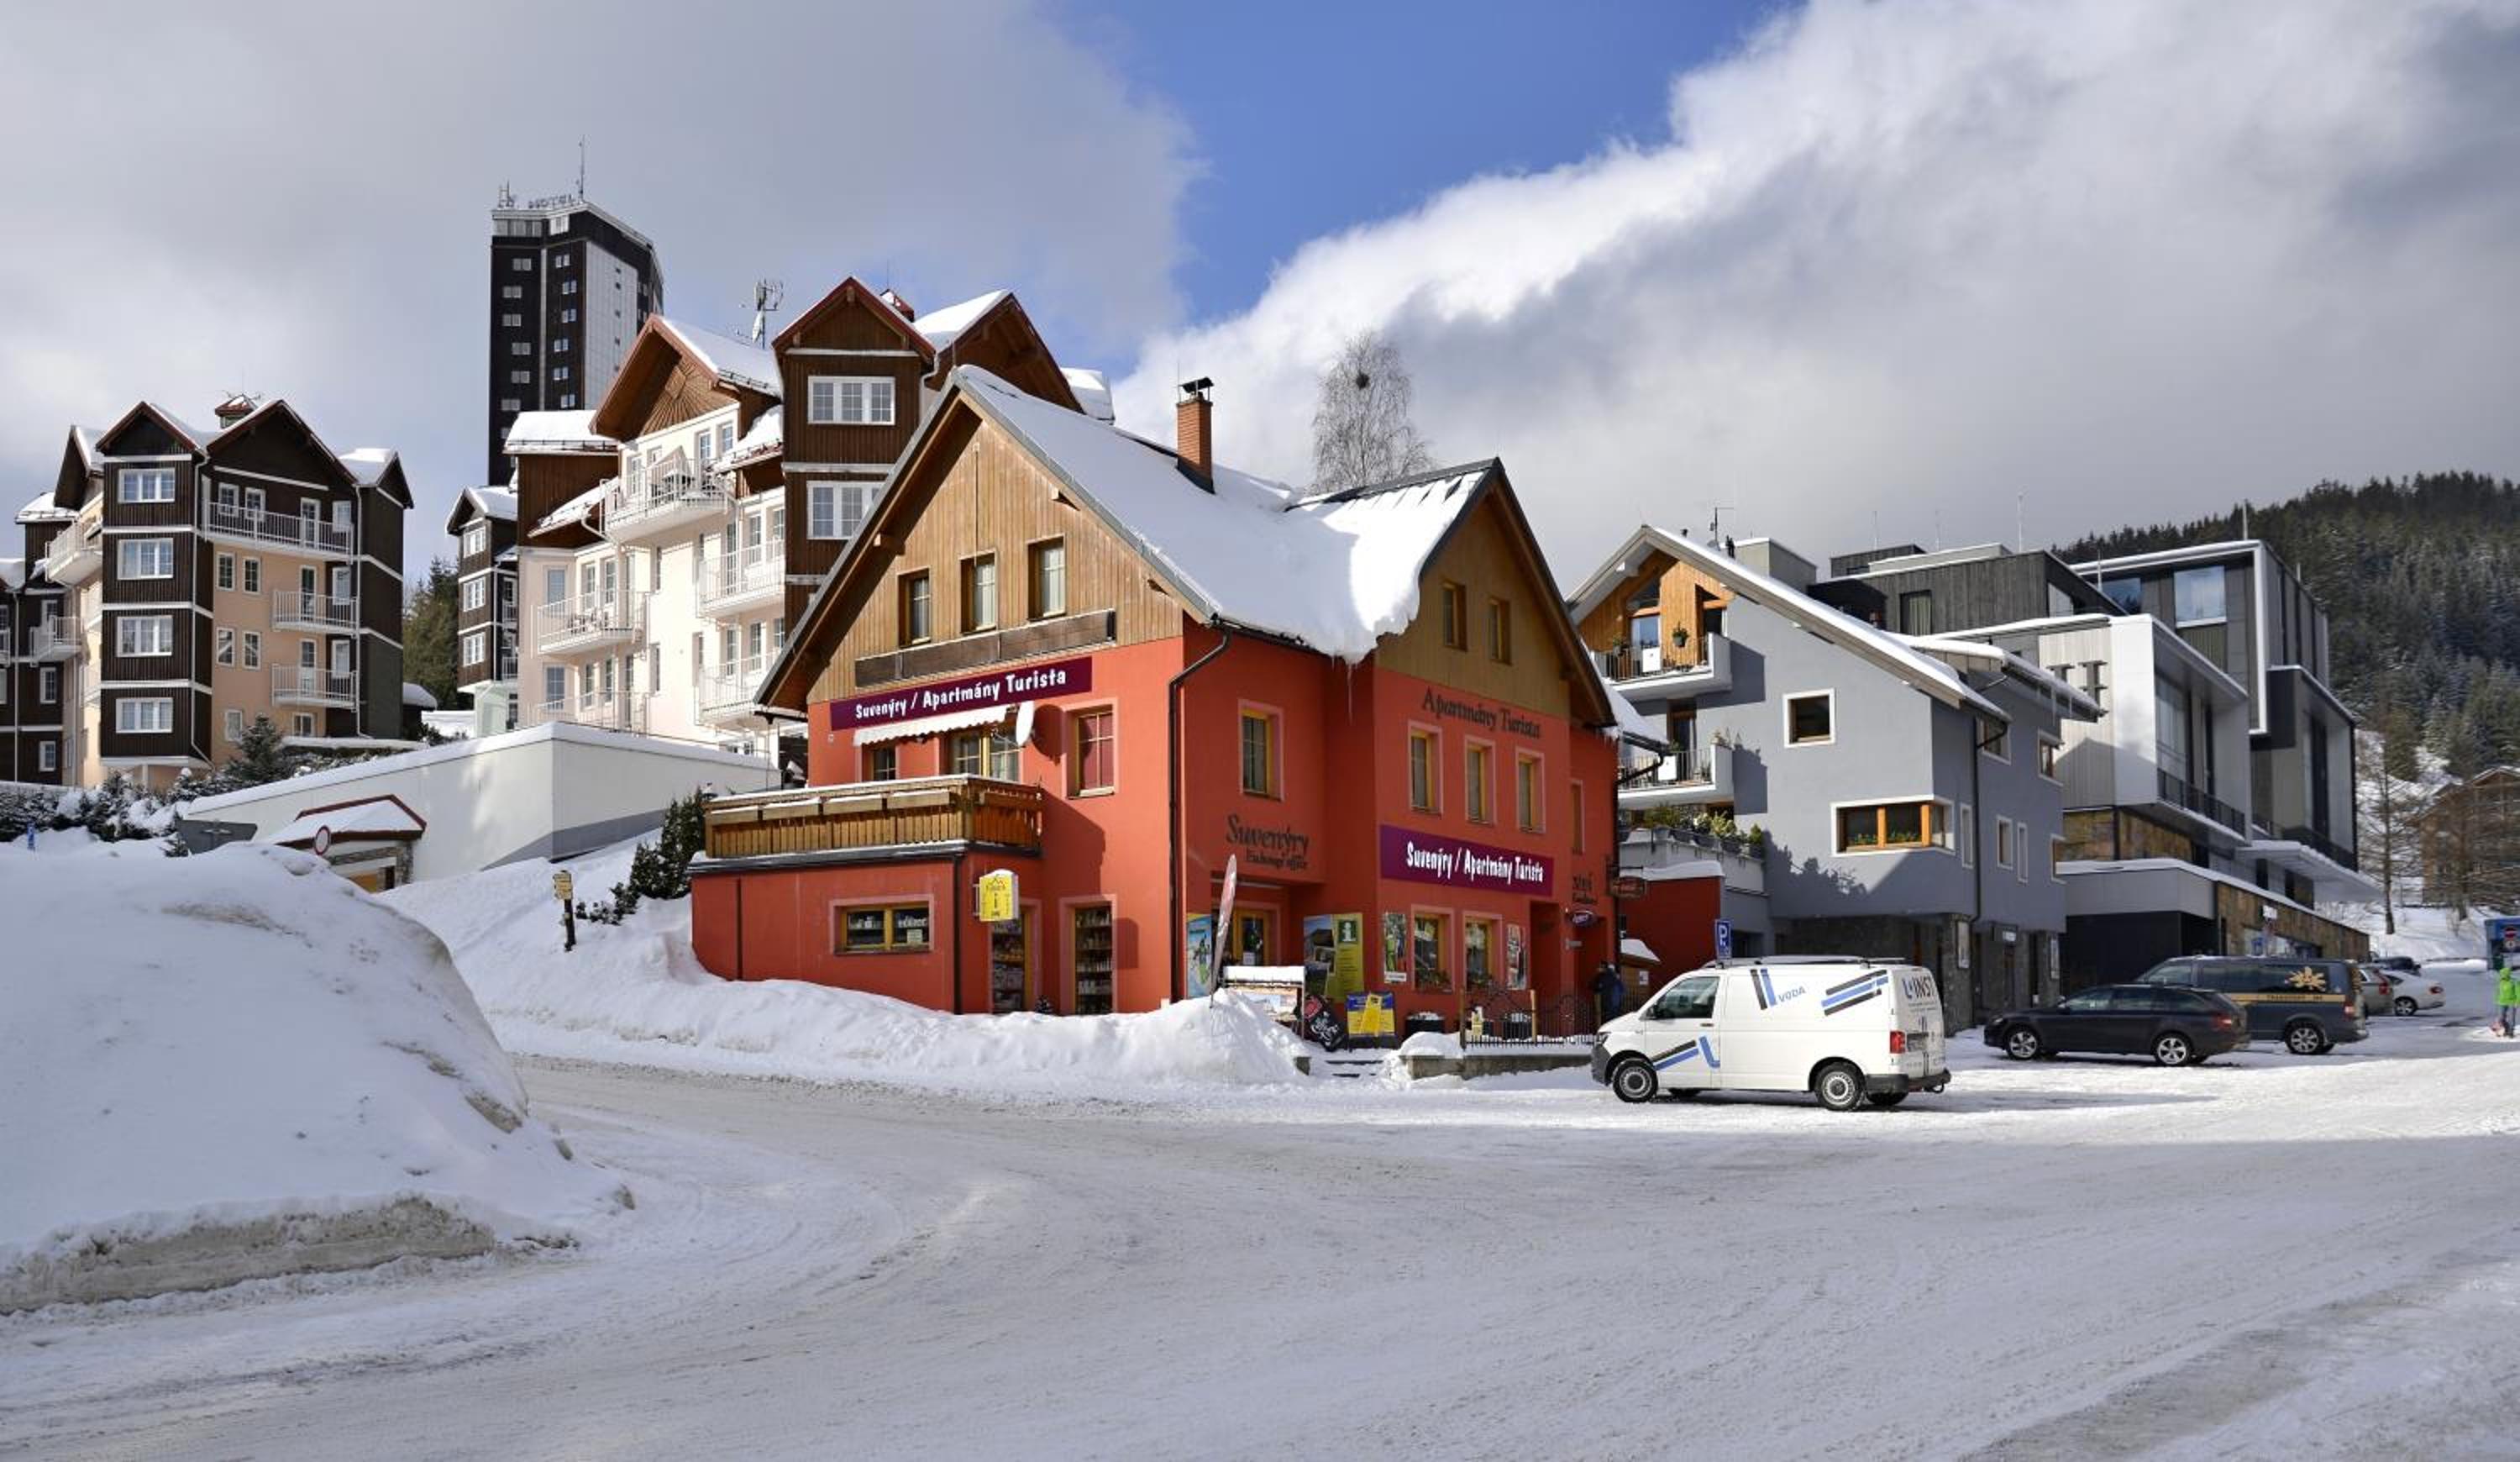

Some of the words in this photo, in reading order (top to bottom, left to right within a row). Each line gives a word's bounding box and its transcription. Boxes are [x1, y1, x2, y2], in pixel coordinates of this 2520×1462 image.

[855, 697, 906, 719] Suvenýry
[910, 692, 919, 710] /
[922, 681, 1000, 708] Apartmány
[1005, 668, 1067, 692] Turista
[1422, 685, 1497, 733] Apartmány
[1499, 707, 1541, 739] Turista
[1226, 813, 1310, 856] Suvenýry
[1406, 840, 1452, 881] Suvenýry
[1454, 847, 1462, 872] /
[1463, 849, 1513, 885] Apartmány
[1515, 855, 1544, 883] Turista
[1777, 986, 1807, 1002] VODA
